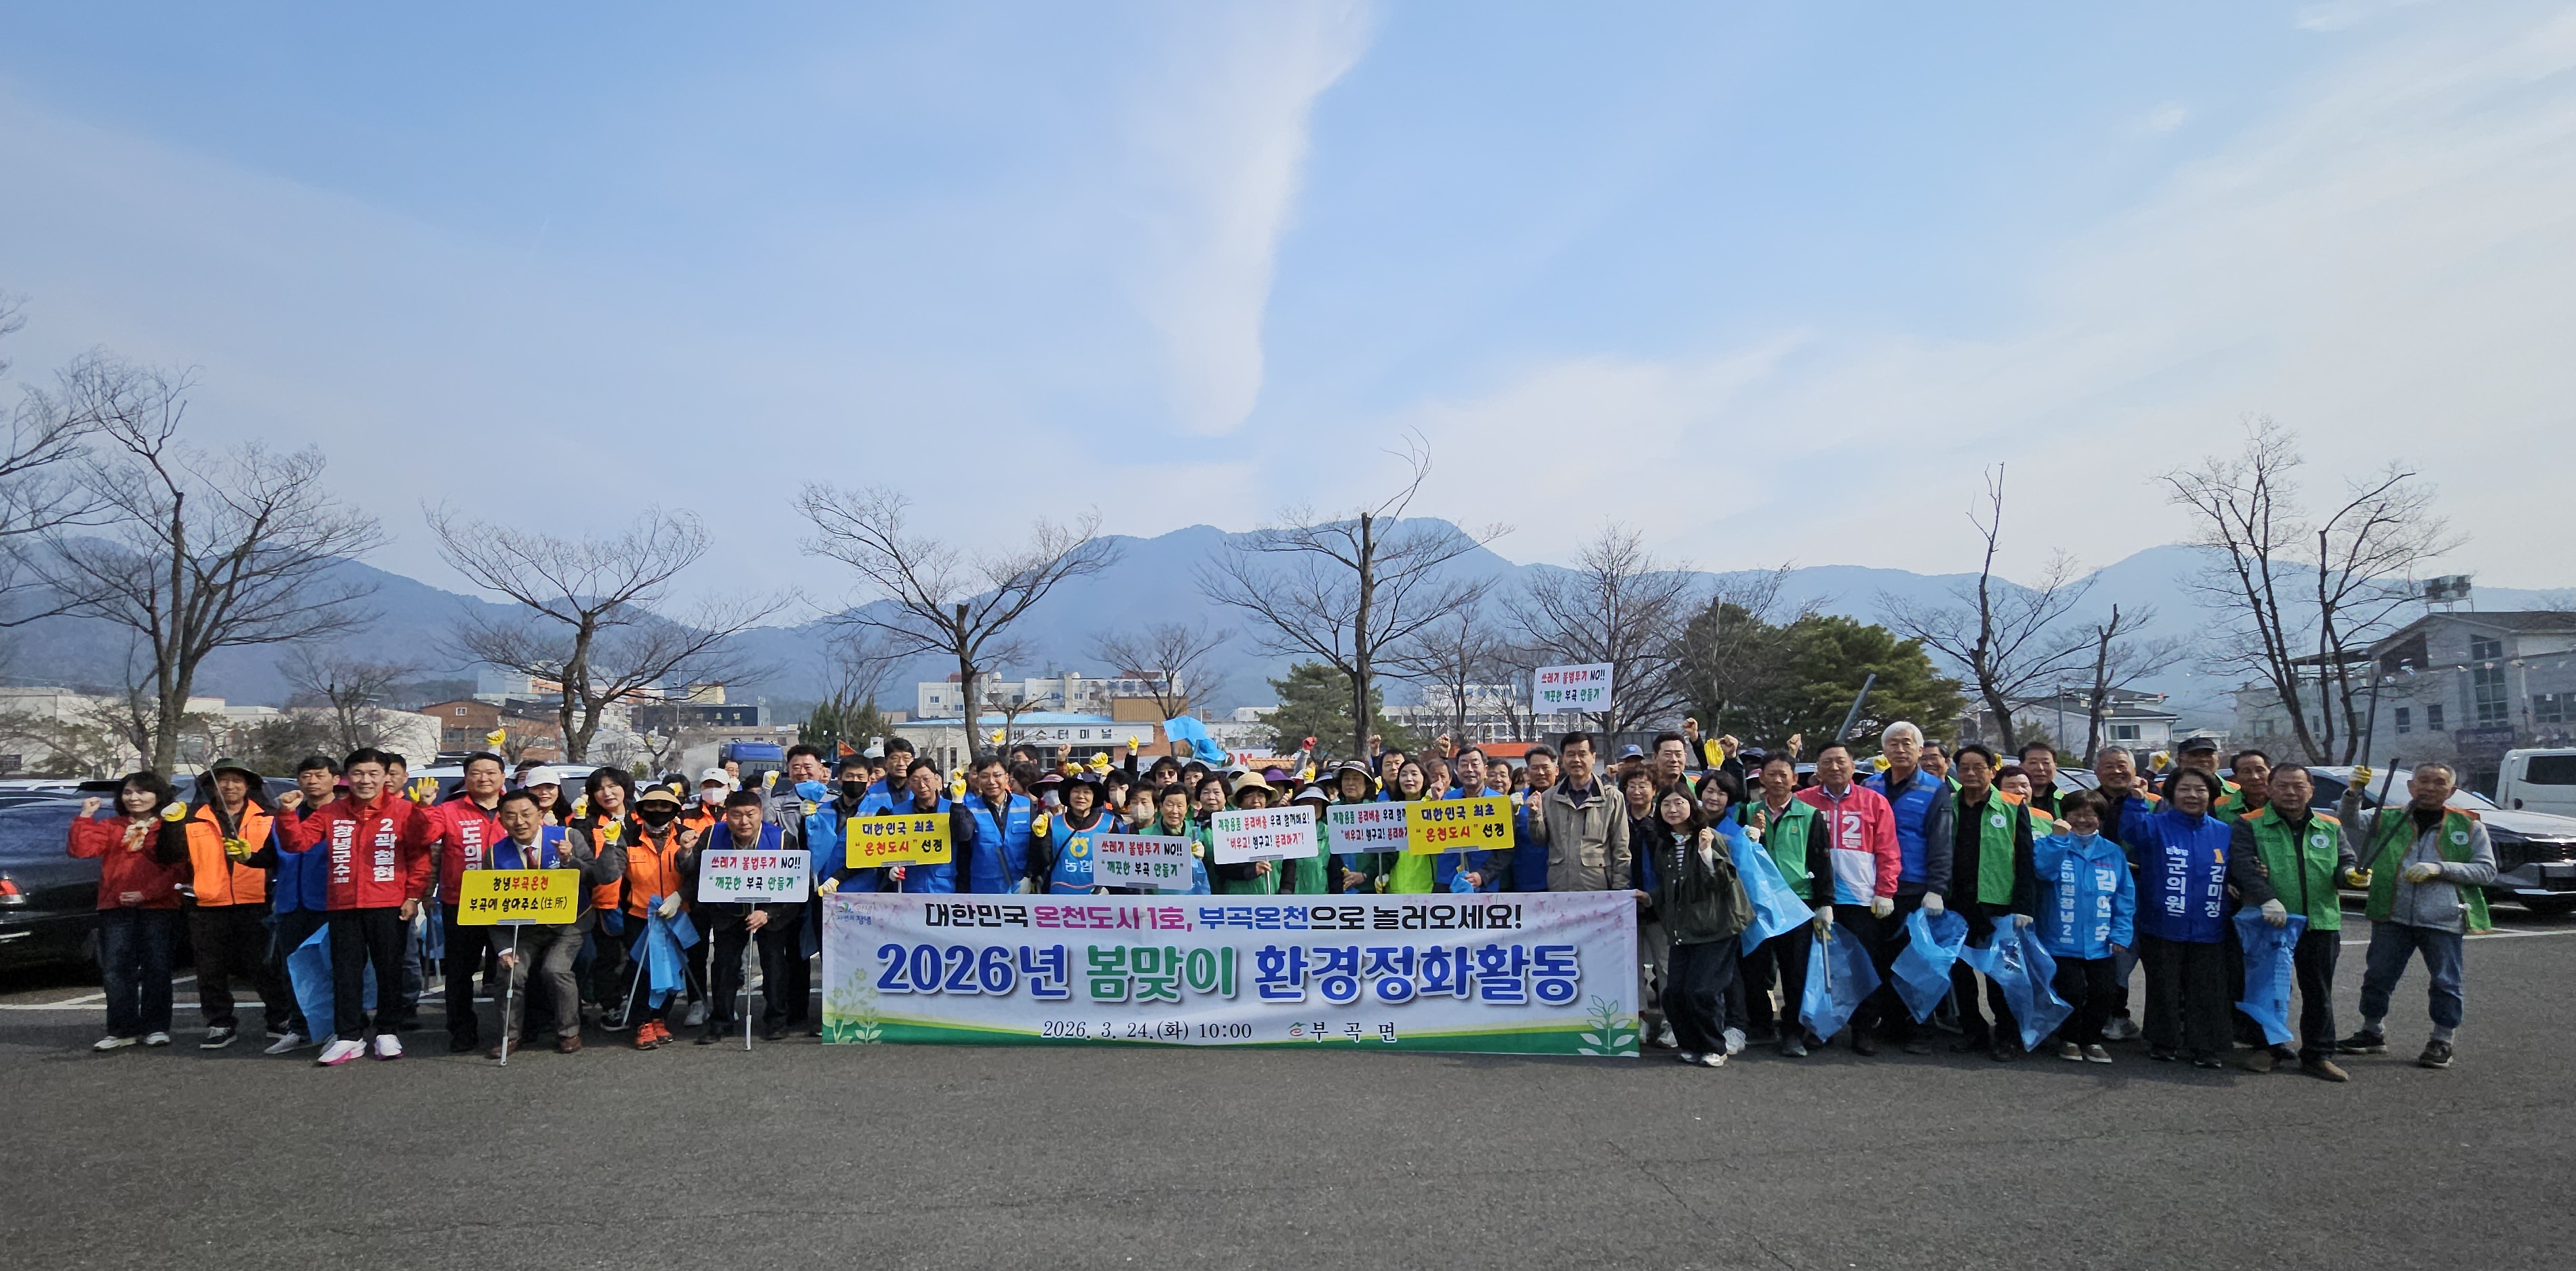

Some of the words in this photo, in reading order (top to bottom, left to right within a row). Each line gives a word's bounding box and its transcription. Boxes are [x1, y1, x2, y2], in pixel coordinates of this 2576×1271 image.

[1541, 671, 1559, 684] 쓰레기
[1562, 670, 1588, 684] 불법투기
[1590, 669, 1605, 681] NO!!
[1565, 689, 1577, 702] 부곡
[1421, 806, 1466, 821] 대한민국
[1474, 803, 1495, 817] 최초
[862, 821, 907, 836] 대한민국
[914, 820, 935, 832] 최초
[1270, 814, 1282, 827] 우리
[1842, 815, 1862, 839] 2
[1482, 823, 1504, 838] 선정
[921, 838, 942, 853] 선정
[1101, 840, 1124, 854] 쓰레기
[1129, 841, 1160, 856] 불법투기
[1164, 843, 1183, 856] NO!!
[373, 833, 398, 882] 곽철현
[711, 856, 737, 869] 쓰레기
[742, 856, 777, 870] 불법투기
[781, 857, 801, 869] NO!!
[1134, 861, 1150, 877] 부곡
[746, 876, 763, 891] 부곡
[2164, 857, 2189, 914] 군의원
[2205, 865, 2227, 918] 김미정
[469, 897, 498, 913] 부곡에
[925, 903, 1029, 928] 대한민국
[1199, 905, 1364, 930] 부곡온천으로
[1373, 904, 1522, 930] 놀러오세요!
[876, 943, 1069, 997] 2026년
[1086, 944, 1233, 1000] 봄맞이
[1254, 944, 1579, 1002] 환경정화활동
[1042, 1020, 1091, 1039] 2026.
[1101, 1021, 1117, 1039] 3.
[1198, 1023, 1252, 1038] 10:00
